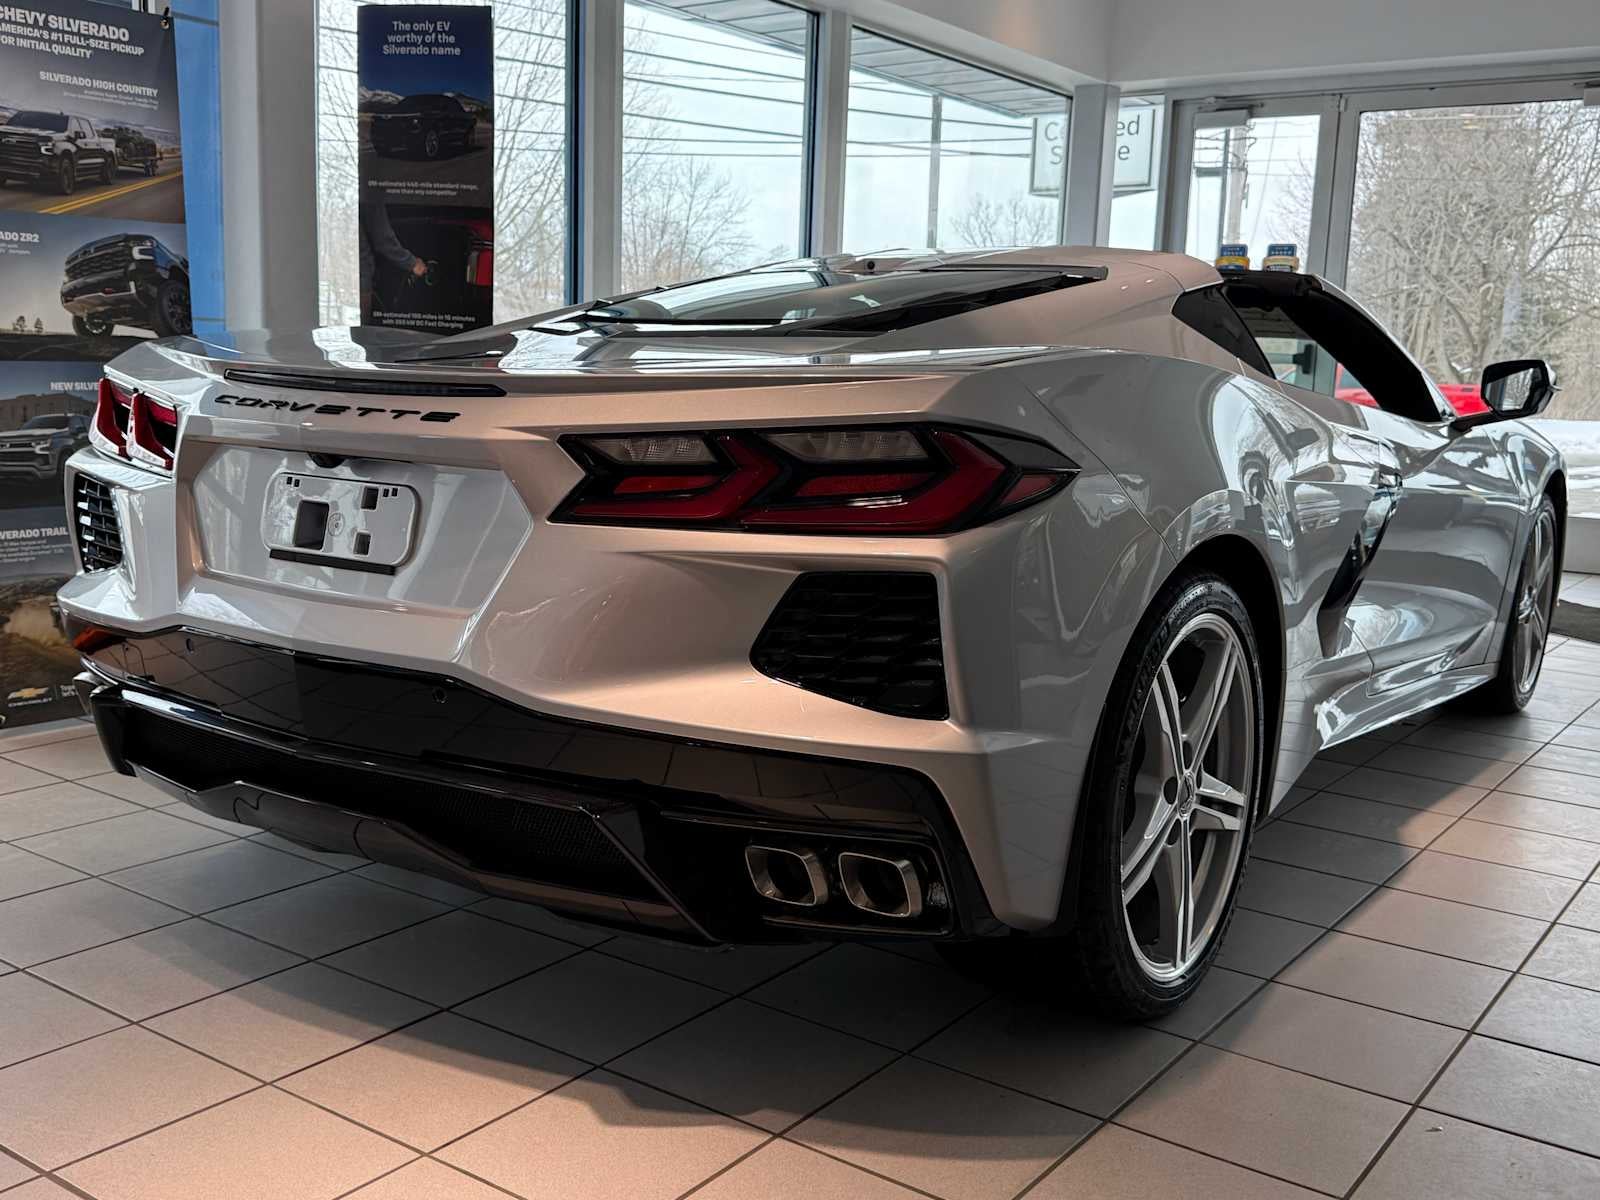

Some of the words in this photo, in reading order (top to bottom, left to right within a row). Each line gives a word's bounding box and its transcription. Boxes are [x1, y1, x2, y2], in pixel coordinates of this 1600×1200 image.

[48, 14, 130, 41] SILVERADO
[392, 20, 411, 31] The
[413, 20, 434, 33] only
[436, 20, 450, 31] EV
[0, 23, 49, 40] MERICA'S
[64, 34, 110, 51] FULL-SIZE
[111, 44, 145, 56] PICKUP
[0, 34, 16, 47] OR
[17, 37, 52, 53] INITIAL
[387, 32, 423, 45] worthy
[425, 32, 436, 43] of
[437, 32, 456, 43] the
[383, 45, 430, 55] Silverado
[431, 47, 461, 56] name
[40, 71, 92, 88] SILVERADO
[116, 83, 159, 97] COUNTRY
[0, 230, 19, 242] ADO
[20, 232, 40, 243] ZR2
[51, 381, 74, 391] NEW
[74, 381, 99, 391] SILVE
[214, 394, 462, 423] CORVETTE
[0, 528, 40, 540] VERADO
[40, 526, 69, 537] TRAIL
